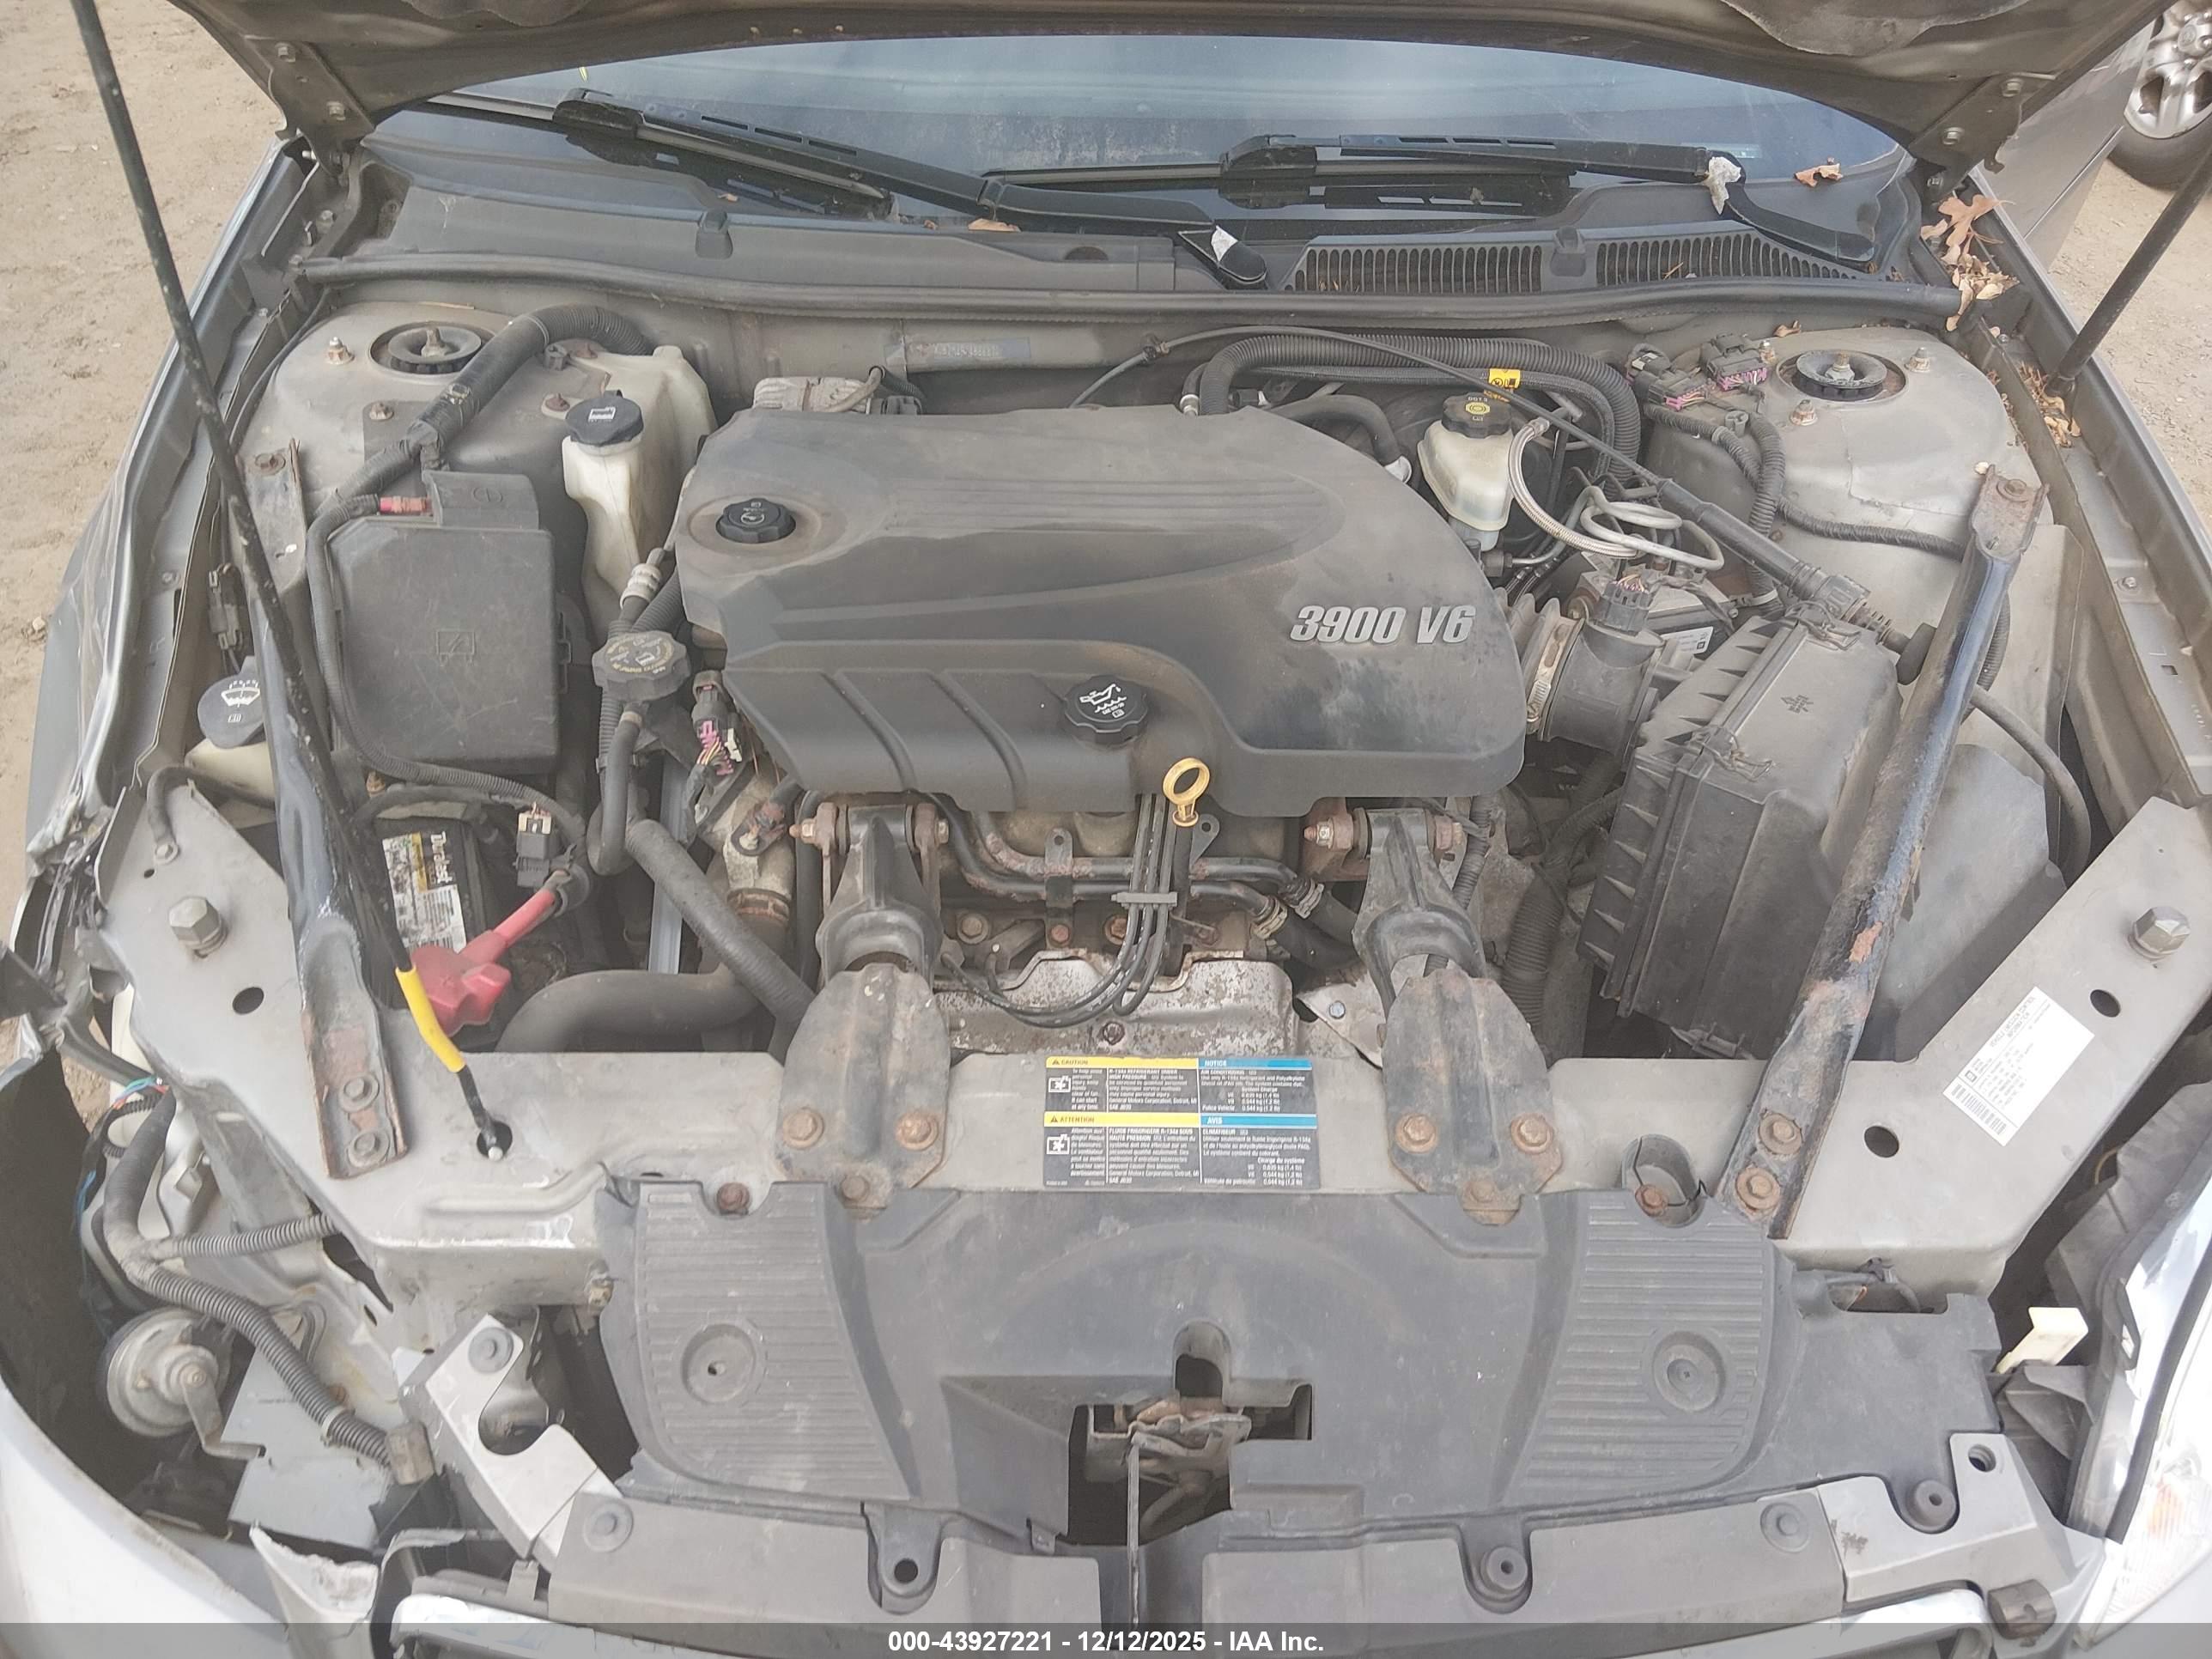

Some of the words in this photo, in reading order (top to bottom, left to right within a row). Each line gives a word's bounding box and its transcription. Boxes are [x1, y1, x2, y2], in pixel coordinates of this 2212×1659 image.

[1290, 605, 1407, 644] 3900
[1417, 605, 1476, 644] V6
[430, 830, 454, 884] Duralast
